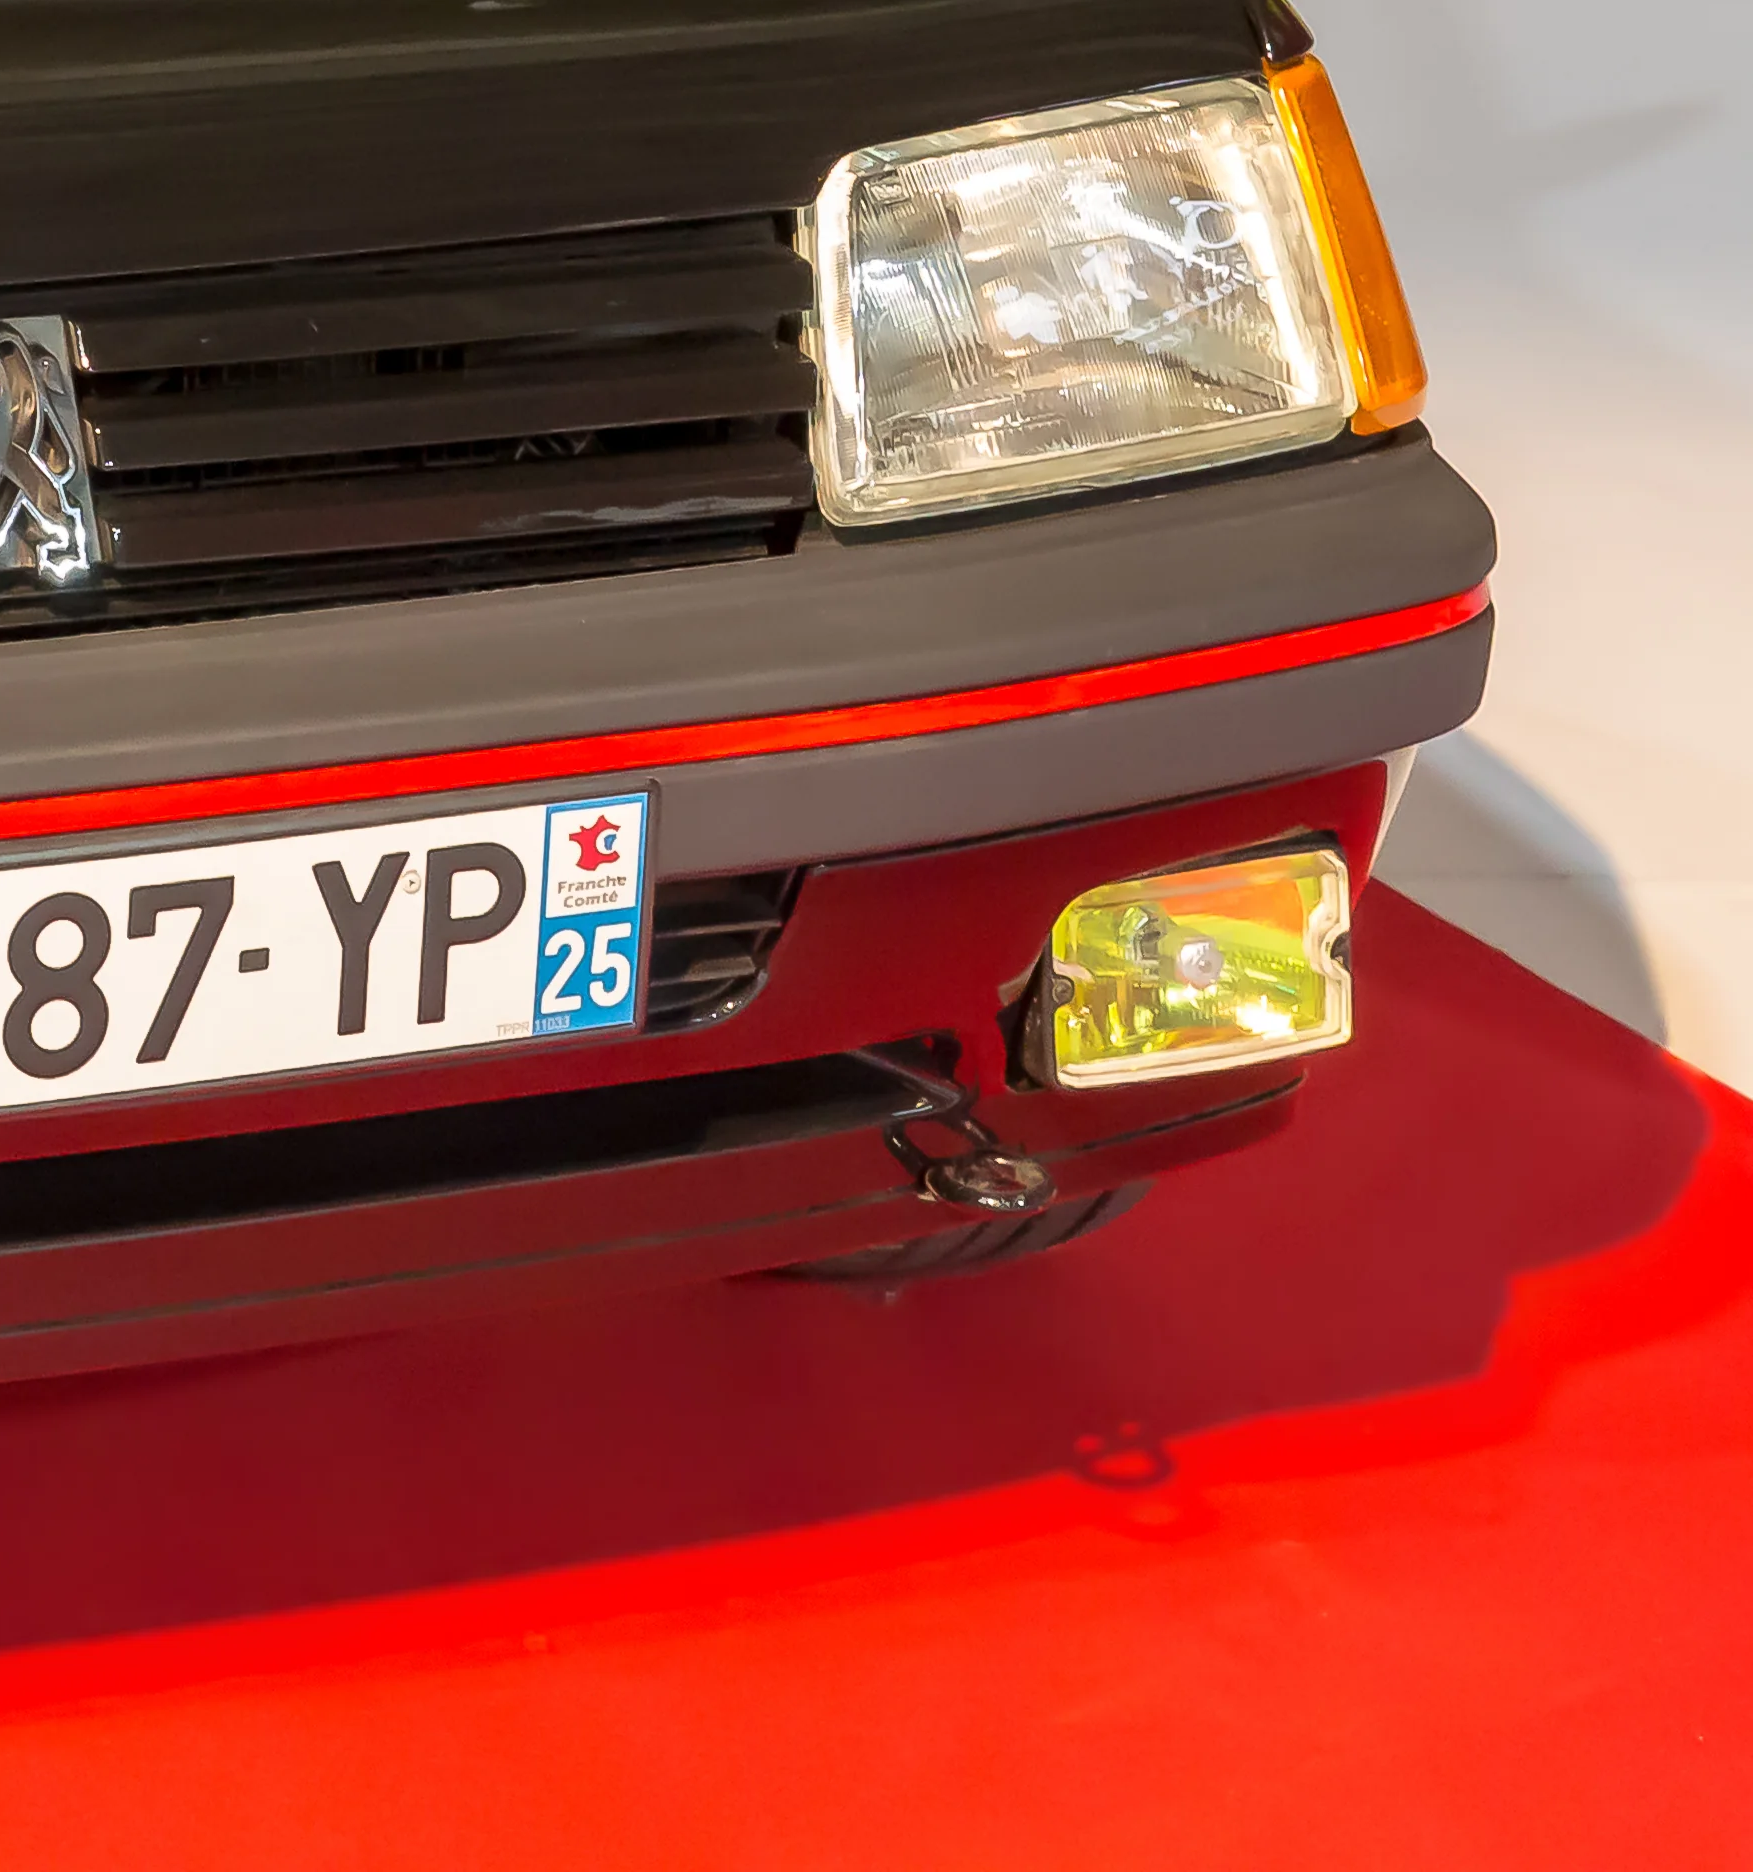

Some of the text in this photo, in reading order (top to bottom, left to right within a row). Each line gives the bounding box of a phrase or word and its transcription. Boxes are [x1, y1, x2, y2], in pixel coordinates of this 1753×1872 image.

[558, 876, 626, 894] Franche
[563, 892, 618, 908] Comté
[541, 923, 631, 1014] 25
